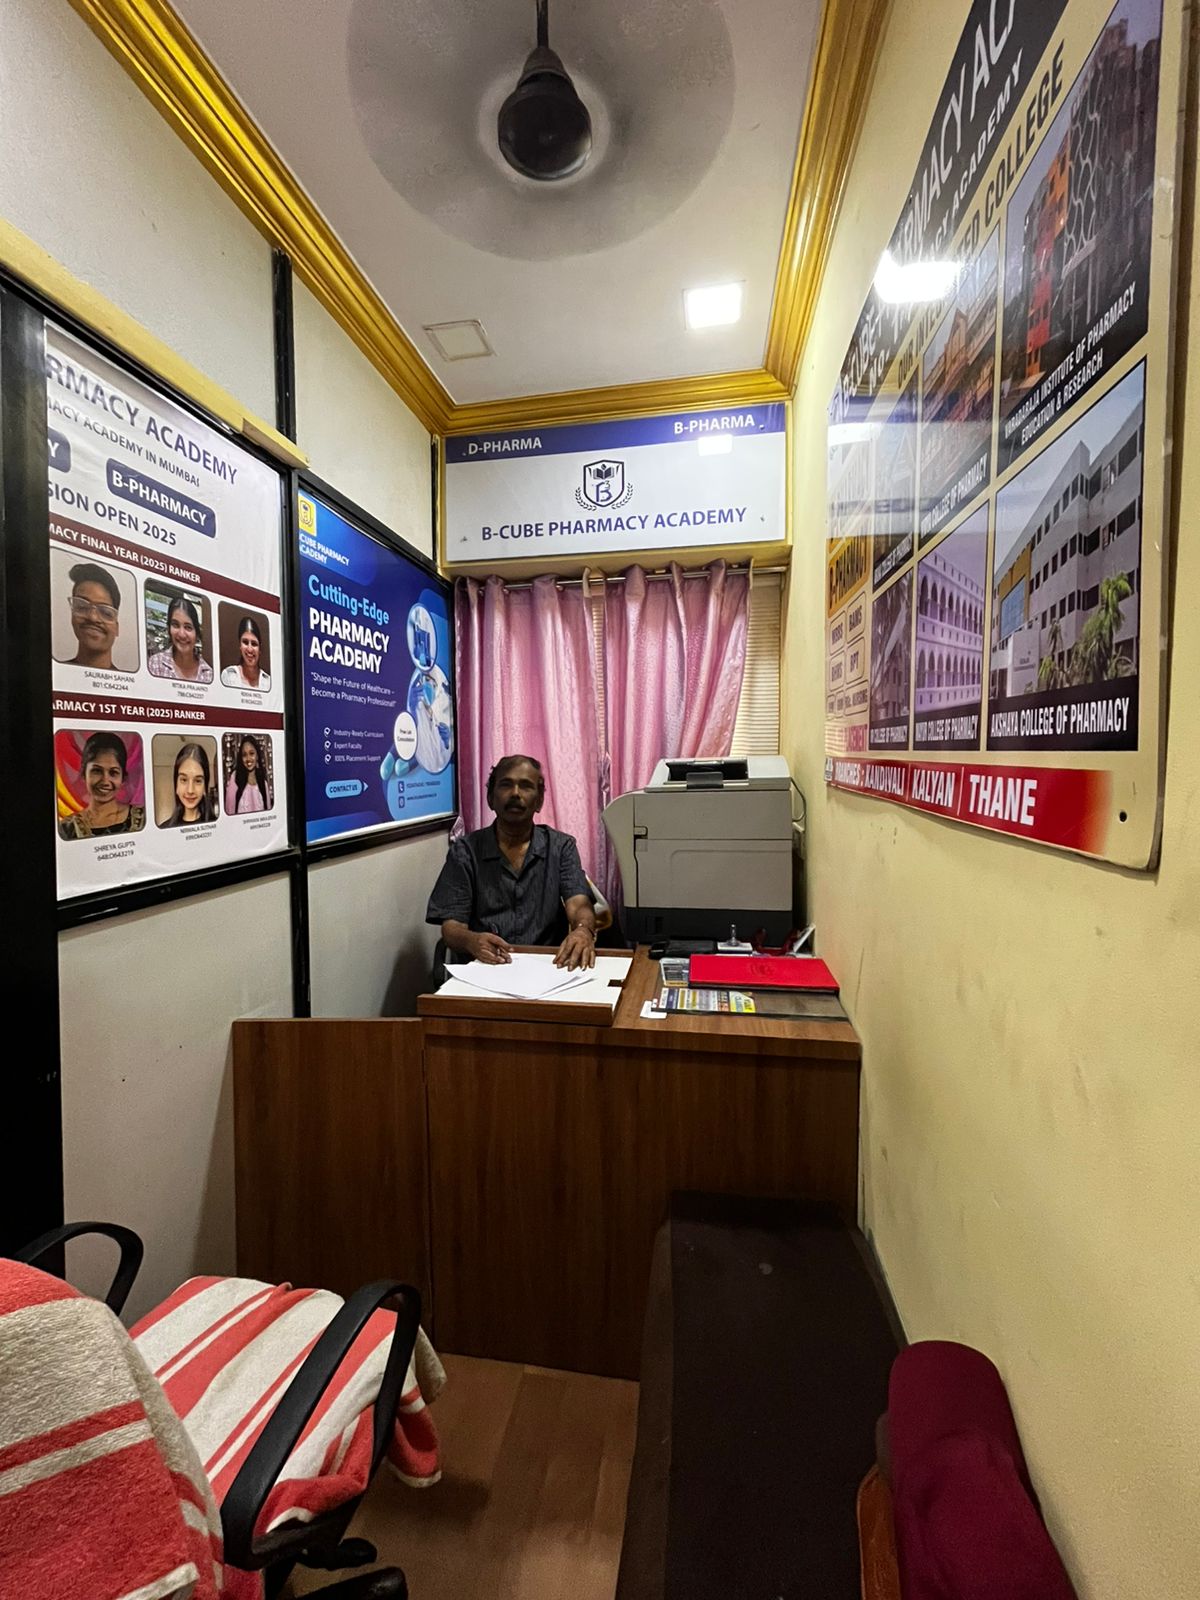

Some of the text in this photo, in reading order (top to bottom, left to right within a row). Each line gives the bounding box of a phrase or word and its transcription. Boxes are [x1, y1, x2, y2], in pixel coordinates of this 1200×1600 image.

[952, 47, 1022, 222] ACADEMY
[985, 38, 1065, 228] COLLEGE
[1040, 351, 1075, 402] INSTITUTE
[1075, 337, 1087, 364] OF
[1087, 281, 1136, 352] PHARMACY
[1022, 398, 1055, 446] EDUCATION
[1063, 348, 1103, 404] RESEARCH
[48, 397, 200, 488] ACY ACADEMY IN MUMBAI
[468, 436, 543, 455] D-PHARMA
[674, 414, 756, 434] B-PHARMA
[145, 415, 238, 485] ACADEMY
[112, 470, 207, 527] B-PHARMACY
[958, 452, 988, 503] PHARMACY
[95, 501, 138, 531] OPEN
[142, 522, 178, 547] 2025
[482, 507, 748, 541] B-CUBE PHARMACY ACADEMY
[80, 531, 112, 554] FINAL
[113, 544, 139, 563] YEAR
[140, 556, 168, 574] (2025)
[168, 564, 201, 584] RANKER
[309, 574, 390, 626] Cutting-Edge
[310, 607, 390, 653] PHARMACY
[309, 636, 382, 674] ACADEMY
[312, 686, 335, 699] Become
[342, 691, 367, 705] Pharmacy
[333, 676, 342, 686] the
[343, 678, 360, 690] Future
[367, 684, 391, 695] Healthcare
[98, 703, 117, 715] 1ST
[119, 704, 145, 717] YEAR
[146, 706, 174, 720] (2025)
[174, 708, 206, 722] RANKER
[954, 715, 979, 740] PHARMACY
[990, 697, 1129, 737] AKSHAYA COLLEGE OF PHARMACY
[329, 785, 351, 794] CONTACT
[864, 764, 906, 797] KANDIVALI
[911, 768, 957, 804] KALYAN
[967, 773, 1038, 826] THANE
